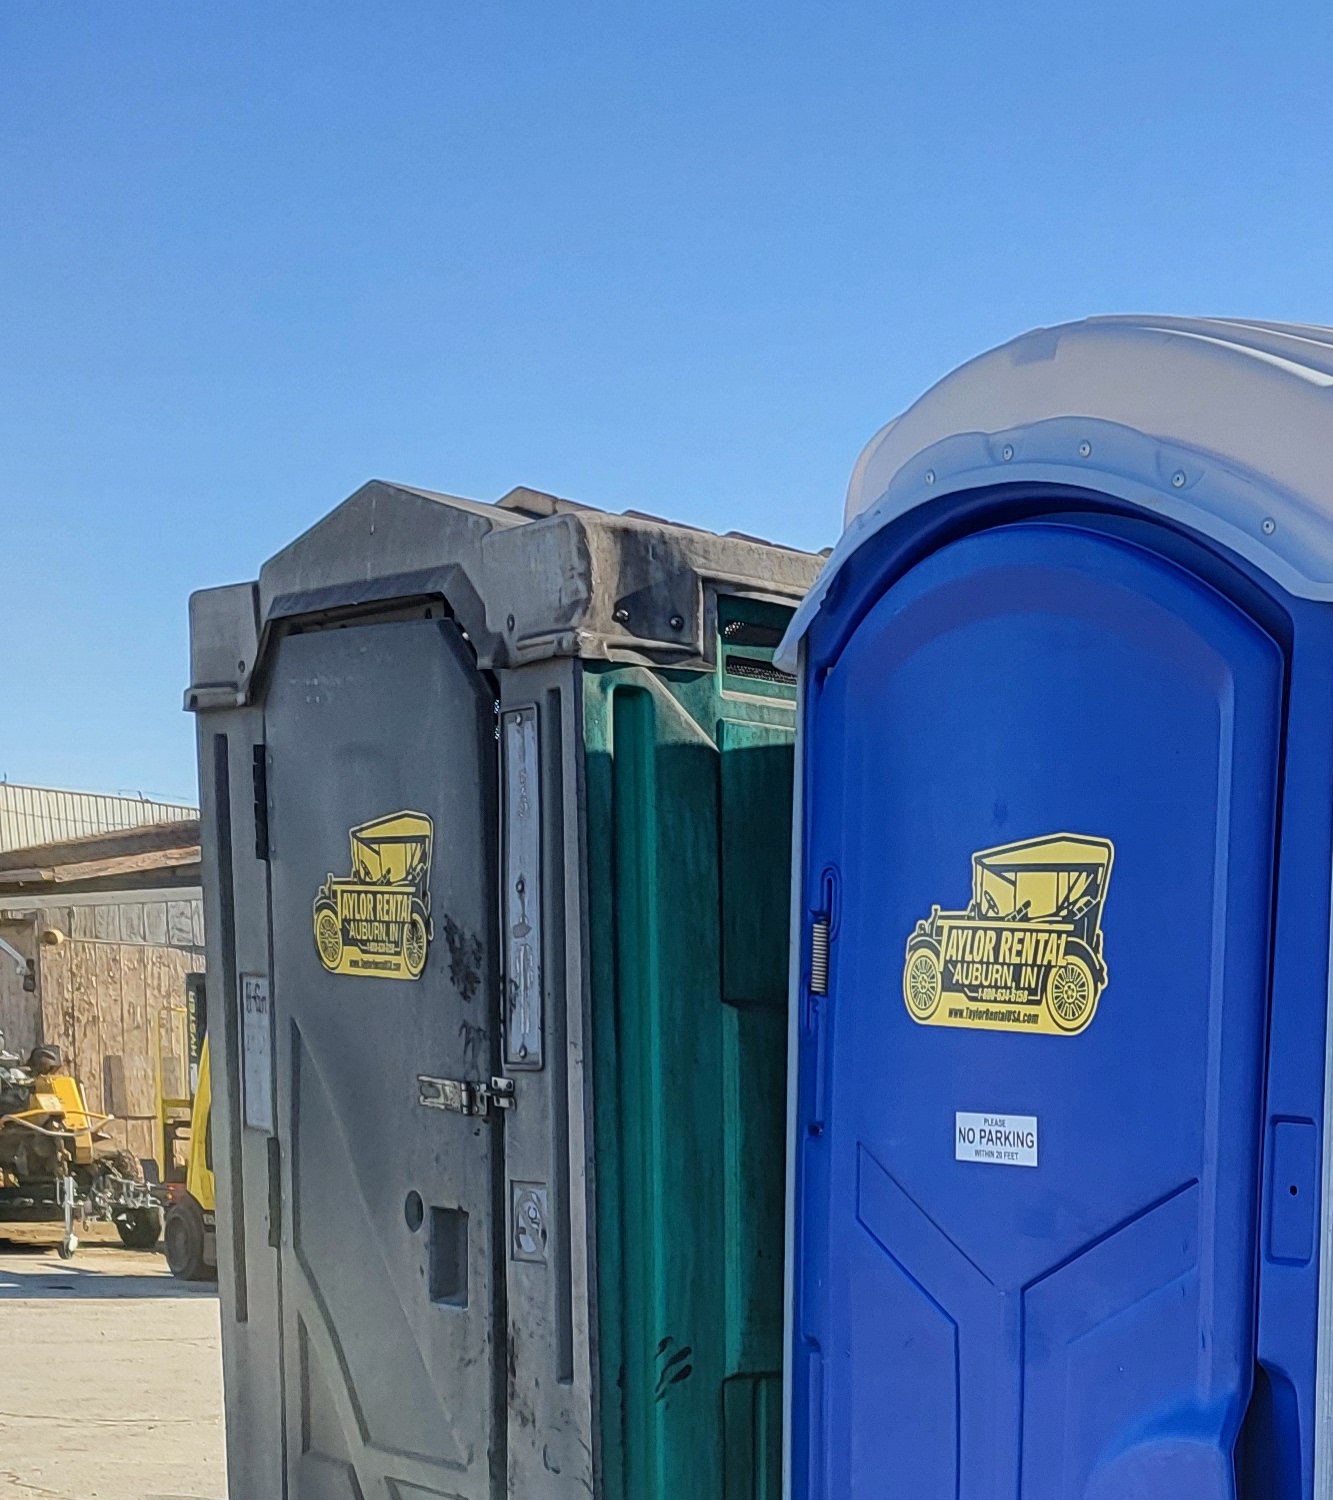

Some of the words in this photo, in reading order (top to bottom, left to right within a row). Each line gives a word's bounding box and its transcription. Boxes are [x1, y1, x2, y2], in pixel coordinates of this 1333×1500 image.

[334, 885, 374, 929] TAYLOR
[349, 921, 388, 943] AUBURN,
[389, 922, 398, 941] IN
[937, 920, 997, 972] TAYLOR
[999, 930, 1067, 966] RENTAL
[952, 962, 1015, 990] AUBURN,
[1020, 966, 1037, 988] IN
[983, 1118, 1006, 1127] PLEASE
[958, 1127, 976, 1144] NO
[979, 1129, 1035, 1149] PARKING
[974, 1149, 995, 1159] WITHIN
[995, 1151, 1003, 1159] 20
[1003, 1151, 1019, 1160] FEET
